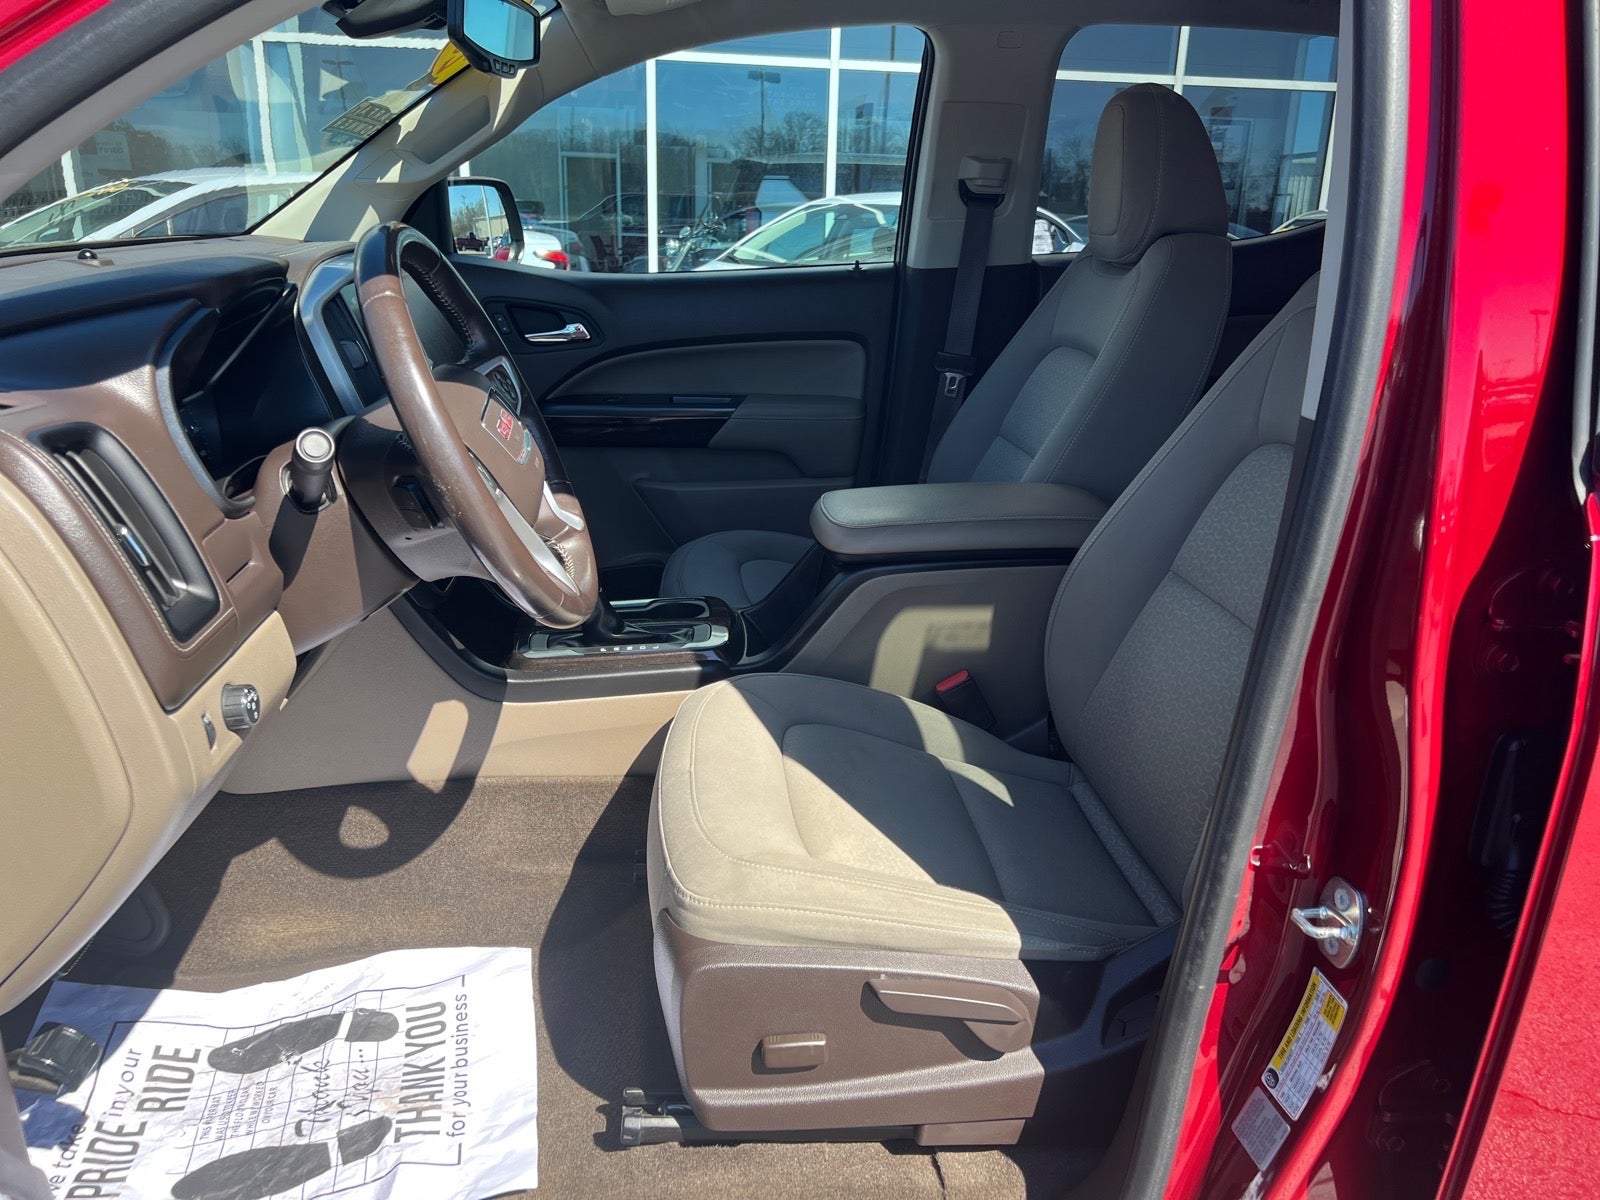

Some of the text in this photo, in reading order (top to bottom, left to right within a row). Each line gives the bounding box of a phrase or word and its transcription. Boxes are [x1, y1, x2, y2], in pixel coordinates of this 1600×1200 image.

[135, 1045, 201, 1112] RIDE
[394, 1001, 447, 1143] THANK YOU
[446, 993, 471, 1137] for your business
[52, 1123, 86, 1169] take
[65, 1120, 148, 1199] PRIDE
